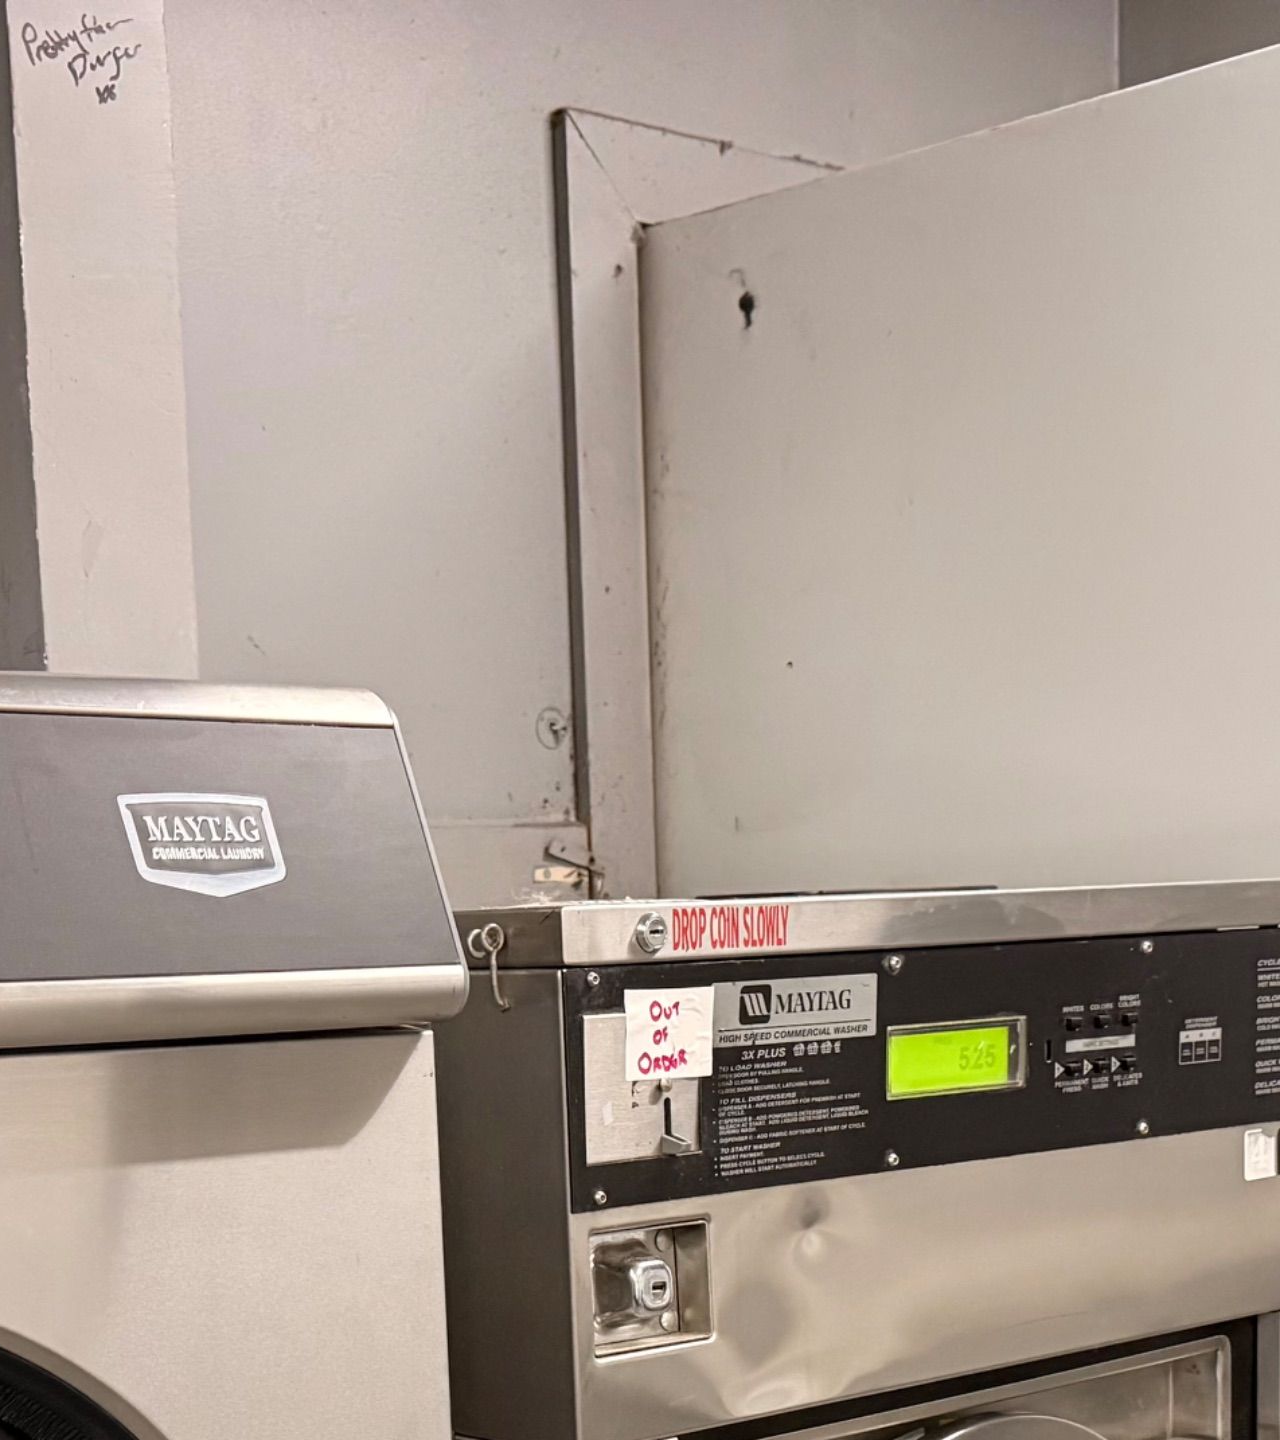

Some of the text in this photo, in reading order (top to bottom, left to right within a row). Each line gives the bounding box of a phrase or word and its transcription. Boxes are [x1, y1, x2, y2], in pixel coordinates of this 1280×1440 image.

[142, 815, 262, 843] MAYTAG
[152, 846, 265, 860] COMMERCIAL LAUNDRY
[672, 905, 790, 952] DROP COIN SLOWLY
[775, 988, 852, 1016] MAYTAG
[719, 1023, 868, 1044] HIGH SPEED COMMERCIAL WASHER
[741, 1047, 787, 1061] 3X PLUS
